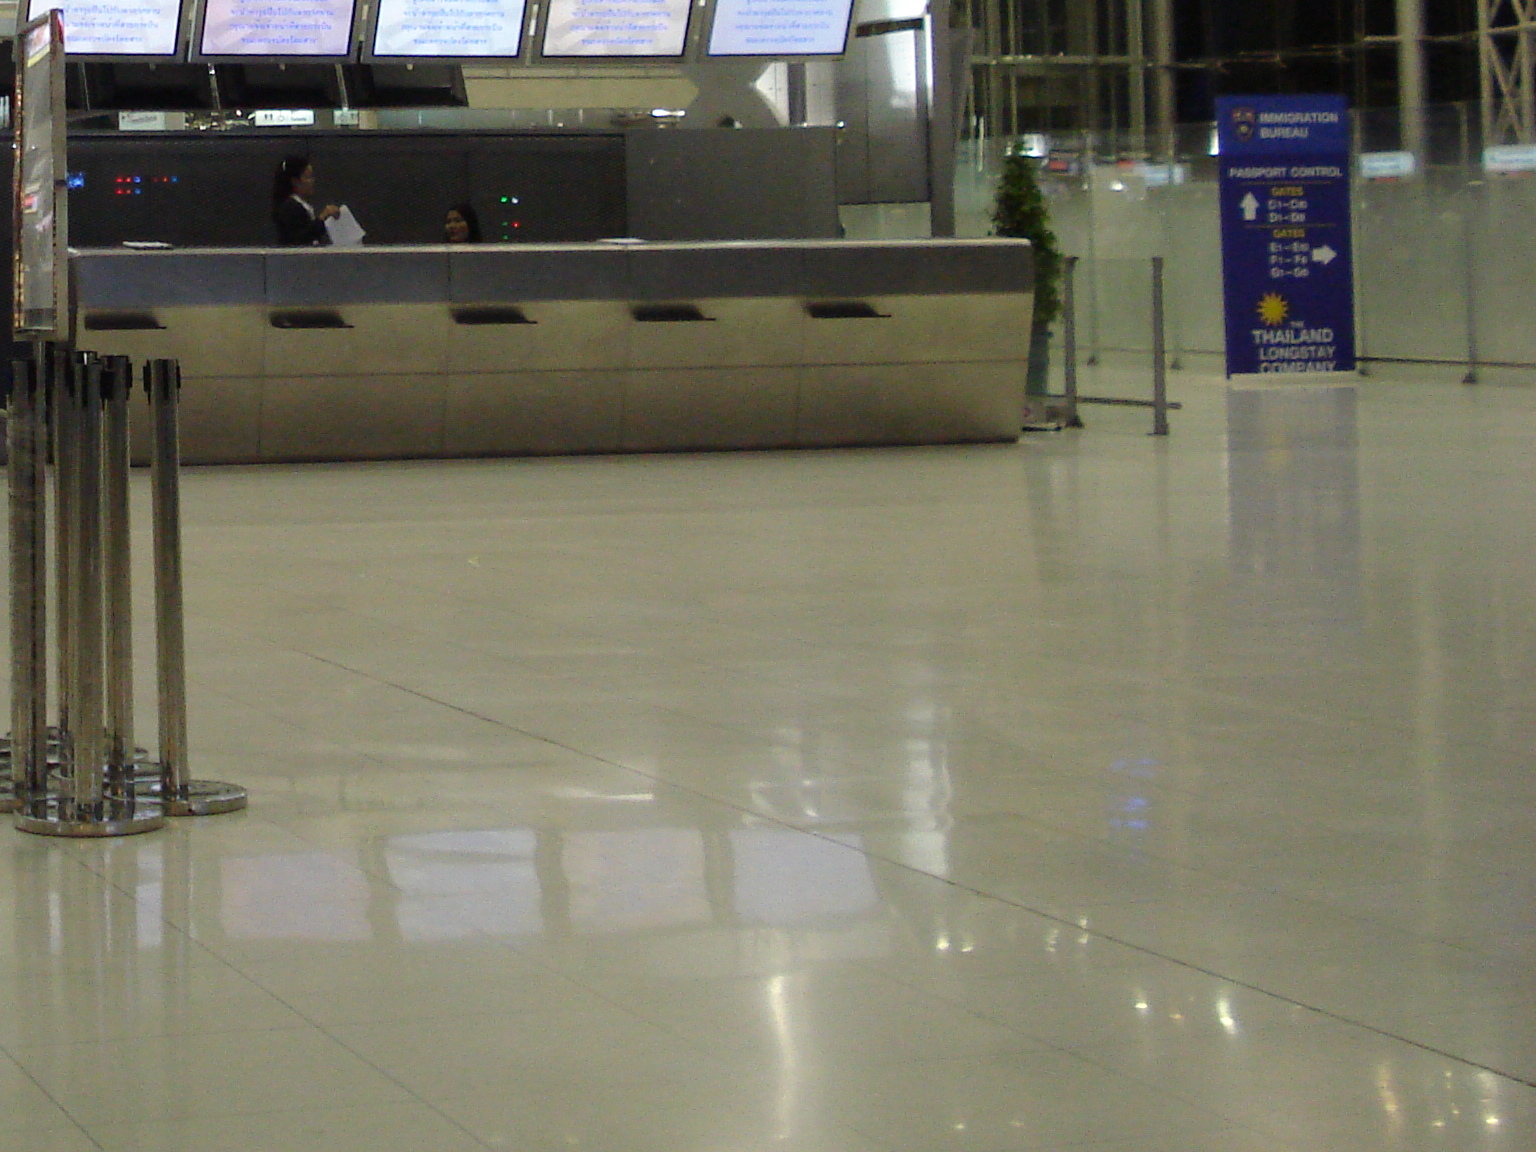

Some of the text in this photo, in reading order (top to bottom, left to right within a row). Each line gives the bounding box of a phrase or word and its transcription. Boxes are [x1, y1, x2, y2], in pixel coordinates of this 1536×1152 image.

[1260, 112, 1339, 124] IMMIGRATION
[1260, 127, 1309, 138] BUREAU
[1229, 166, 1343, 178] PASSPORT CONTROL
[1252, 328, 1334, 344] THAILAND
[1259, 346, 1336, 360] LONGSTAY
[1260, 360, 1336, 373] COMPANY
